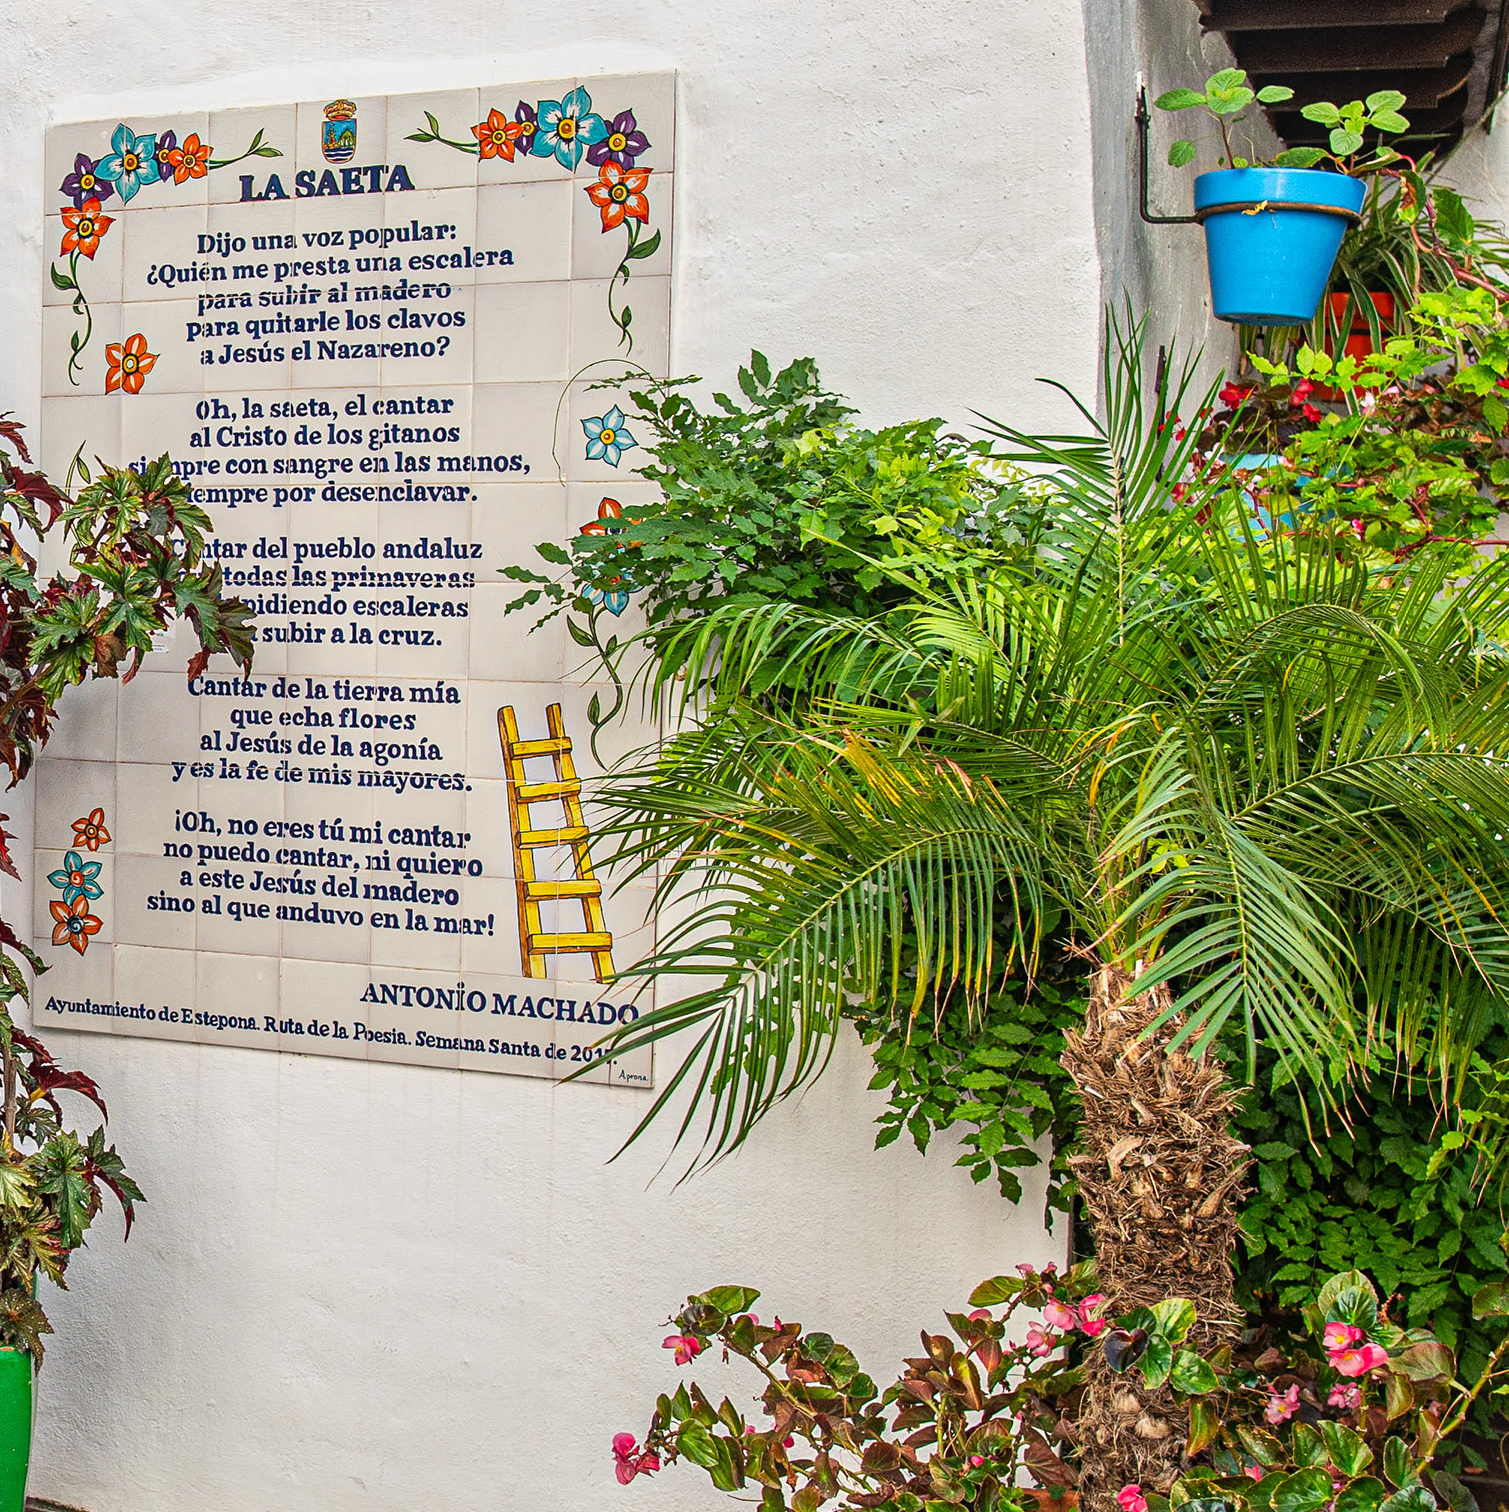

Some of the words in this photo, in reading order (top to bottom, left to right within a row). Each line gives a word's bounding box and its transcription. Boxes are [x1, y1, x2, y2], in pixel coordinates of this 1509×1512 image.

[238, 173, 289, 202] LA
[295, 164, 414, 198] SAETA
[197, 231, 247, 258] Dijo
[251, 234, 298, 251] una
[301, 231, 345, 248] voz
[348, 219, 457, 251] popular:
[146, 261, 228, 289] ¿Quién
[232, 263, 269, 280] me
[273, 256, 351, 283] presta
[354, 256, 403, 273] una
[408, 246, 515, 271] escalera
[197, 292, 253, 317] para
[258, 282, 322, 308] subir
[327, 281, 348, 304] al
[354, 278, 452, 303] madero
[186, 320, 241, 342] para
[245, 310, 341, 340] quitarle
[344, 309, 381, 331] los
[387, 307, 466, 330] clavos
[200, 349, 215, 365] a
[218, 340, 285, 365] Jesús
[291, 339, 312, 361] el
[317, 335, 451, 360] Nazareno?
[195, 398, 237, 423] Oh,
[242, 397, 265, 419] la
[269, 398, 338, 421] saeta,
[344, 393, 368, 416] el
[372, 396, 455, 416] cantar
[189, 426, 212, 448] al
[216, 425, 288, 448] Cristo
[293, 425, 322, 446] de
[327, 423, 363, 445] los
[367, 422, 460, 452] gitanos
[128, 455, 221, 481] sipre
[225, 458, 269, 475] con
[273, 457, 354, 480] sangre
[359, 456, 390, 473] en
[394, 451, 431, 474] las
[436, 454, 531, 475] manos,
[186, 481, 268, 509] iempre
[272, 486, 316, 508] por
[321, 478, 478, 503] desenclavar.
[171, 538, 248, 559] Cntar
[252, 536, 288, 559] del
[292, 536, 376, 564] pueblo
[382, 536, 483, 560] andaluz
[221, 564, 288, 588] todas
[291, 565, 327, 587] las
[330, 564, 476, 593] primaveras
[352, 595, 469, 618] escaleras
[262, 621, 327, 644] subir
[330, 627, 346, 644] a
[349, 622, 374, 645] la
[378, 629, 442, 646] cruz.
[187, 675, 268, 698] Cantar
[271, 676, 301, 699] de
[304, 677, 330, 700] la
[333, 679, 405, 702] tierra
[408, 680, 462, 705] mía
[229, 708, 273, 730] que
[278, 705, 335, 728] echa
[338, 707, 417, 731] flores
[199, 730, 222, 752] al
[225, 730, 293, 755] Jesús
[297, 733, 327, 756] de
[331, 735, 355, 757] la
[359, 736, 444, 767] agonía
[171, 761, 188, 783] y
[189, 761, 215, 779] es
[218, 757, 242, 780] la
[246, 759, 269, 781] fe
[274, 759, 303, 783] de
[307, 762, 352, 786] mis
[357, 769, 473, 795] mayores.
[175, 809, 222, 837] ¡Oh,
[227, 818, 259, 836] no
[263, 820, 315, 840] eres
[317, 817, 345, 842] tú
[348, 820, 384, 845] mi
[387, 825, 471, 849] cantar
[162, 842, 194, 859] no
[196, 841, 271, 867] puedo
[275, 847, 360, 871] cantar,
[364, 849, 392, 872] ni
[396, 851, 483, 880] quiero
[179, 870, 194, 887] a
[198, 869, 245, 890] este
[249, 868, 317, 896] Jesús
[321, 874, 359, 899] del
[362, 877, 460, 907] madero
[146, 889, 196, 913] sino
[201, 894, 222, 915] al
[226, 901, 271, 922] que
[275, 901, 364, 927] anduvo
[370, 912, 401, 930] en
[405, 908, 430, 932] la
[433, 913, 495, 937] mar!
[490, 992, 639, 1026] MACHADO
[44, 996, 157, 1021] Ayuntamiento
[157, 1005, 180, 1023] de
[180, 1007, 261, 1031] Estepona.
[263, 1015, 306, 1035] Ruta
[306, 1019, 330, 1038] de
[332, 1020, 350, 1040] la
[352, 1021, 412, 1046] Poesia.
[414, 1030, 486, 1053] Semana
[488, 1039, 542, 1058] Santa
[544, 1042, 567, 1061] de
